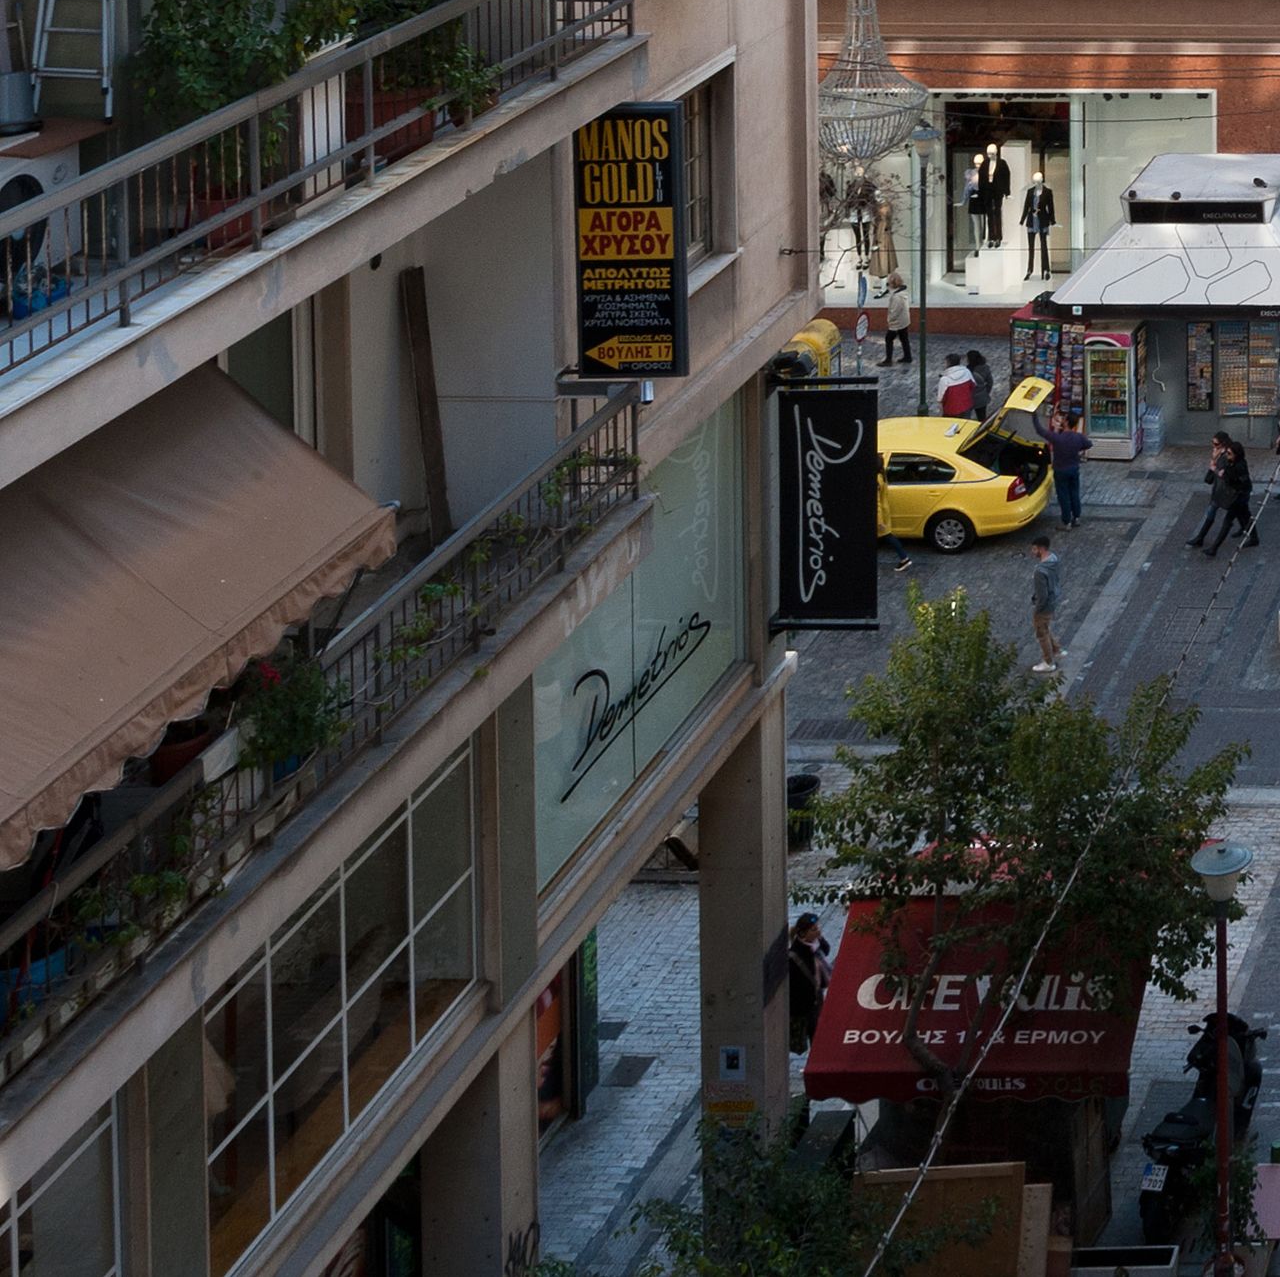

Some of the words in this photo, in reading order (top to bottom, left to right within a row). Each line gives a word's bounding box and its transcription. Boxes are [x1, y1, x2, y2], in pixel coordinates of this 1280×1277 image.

[578, 118, 669, 161] MANOS
[583, 161, 655, 205] GOLD
[589, 210, 662, 232] ΑΓΟΡΑ
[581, 233, 672, 256] ΧΡΥΣΟΥ
[582, 267, 671, 279] ΑΠΟΛΥΤΩΣ
[582, 278, 671, 290] ΜΕΤΡΗΤΟΙΣ
[597, 346, 653, 360] ΒΟΥΛΗΣ
[657, 345, 672, 359] 17
[794, 404, 864, 603] Demetrios
[561, 611, 712, 804] Demetrios
[956, 1029, 984, 1045] 1
[1013, 1030, 1106, 1045] ΕΡΜΟΥ
